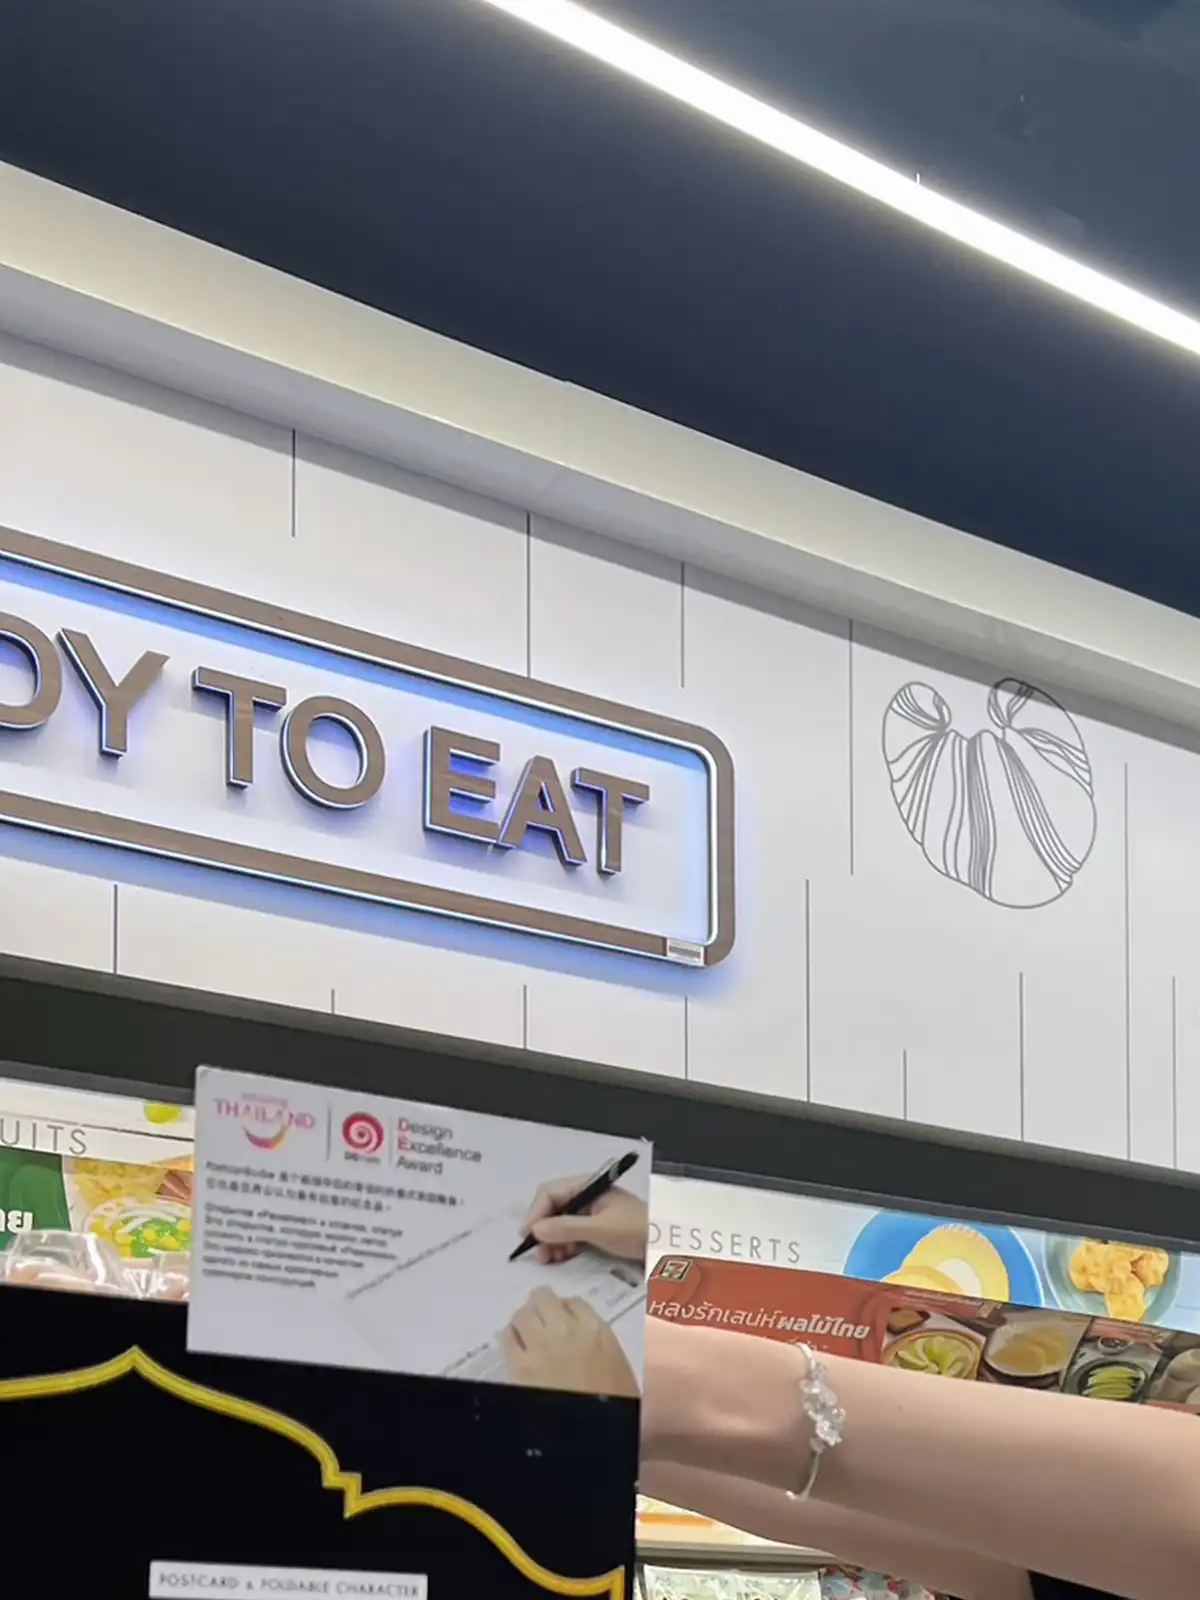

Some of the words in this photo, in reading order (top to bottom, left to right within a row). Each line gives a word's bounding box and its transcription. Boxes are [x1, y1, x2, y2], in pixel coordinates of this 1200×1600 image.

[192, 666, 386, 811] TO
[423, 725, 650, 876] EAT
[398, 1117, 453, 1141] Design
[397, 1156, 444, 1176] Award
[650, 1221, 801, 1264] DESSERTS
[158, 1572, 239, 1591] POSTCARD
